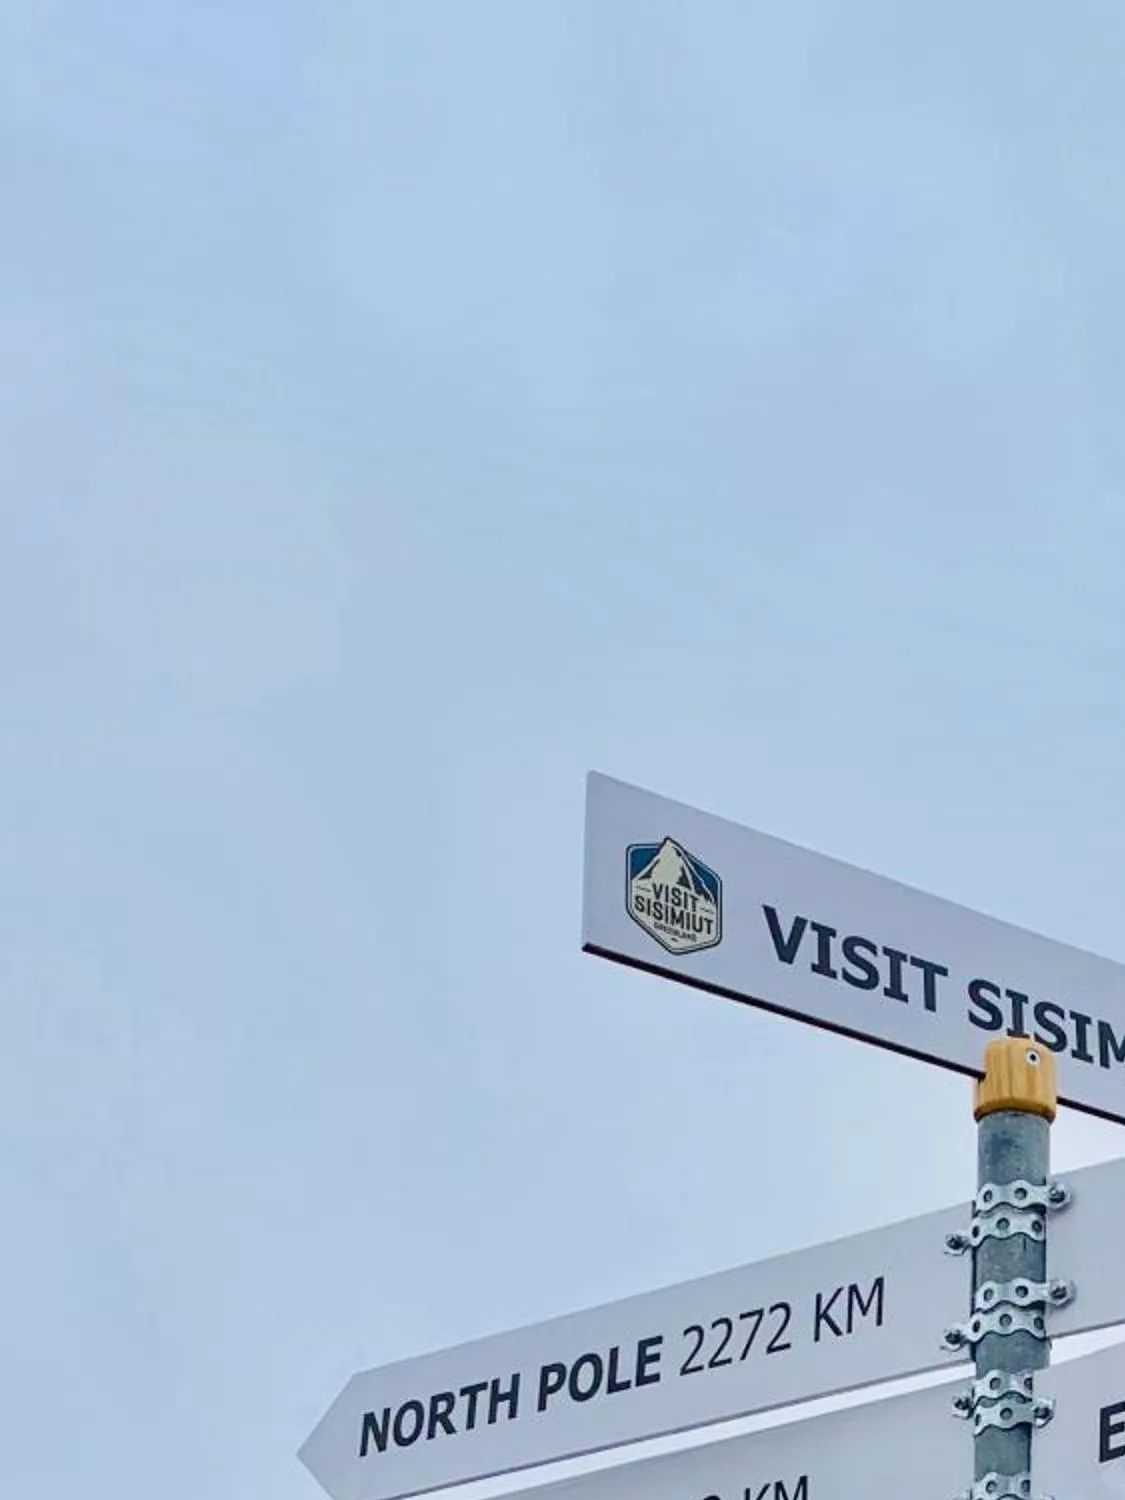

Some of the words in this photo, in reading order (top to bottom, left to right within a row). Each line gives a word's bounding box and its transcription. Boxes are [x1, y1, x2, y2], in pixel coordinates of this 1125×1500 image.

[634, 895, 714, 935] SISIMIUT
[652, 883, 699, 912] VISIT
[762, 905, 948, 1011] VISIT
[359, 1373, 520, 1457] NORTH
[538, 1335, 663, 1411] POLE
[679, 1301, 792, 1376] 2272
[813, 1276, 885, 1342] KM
